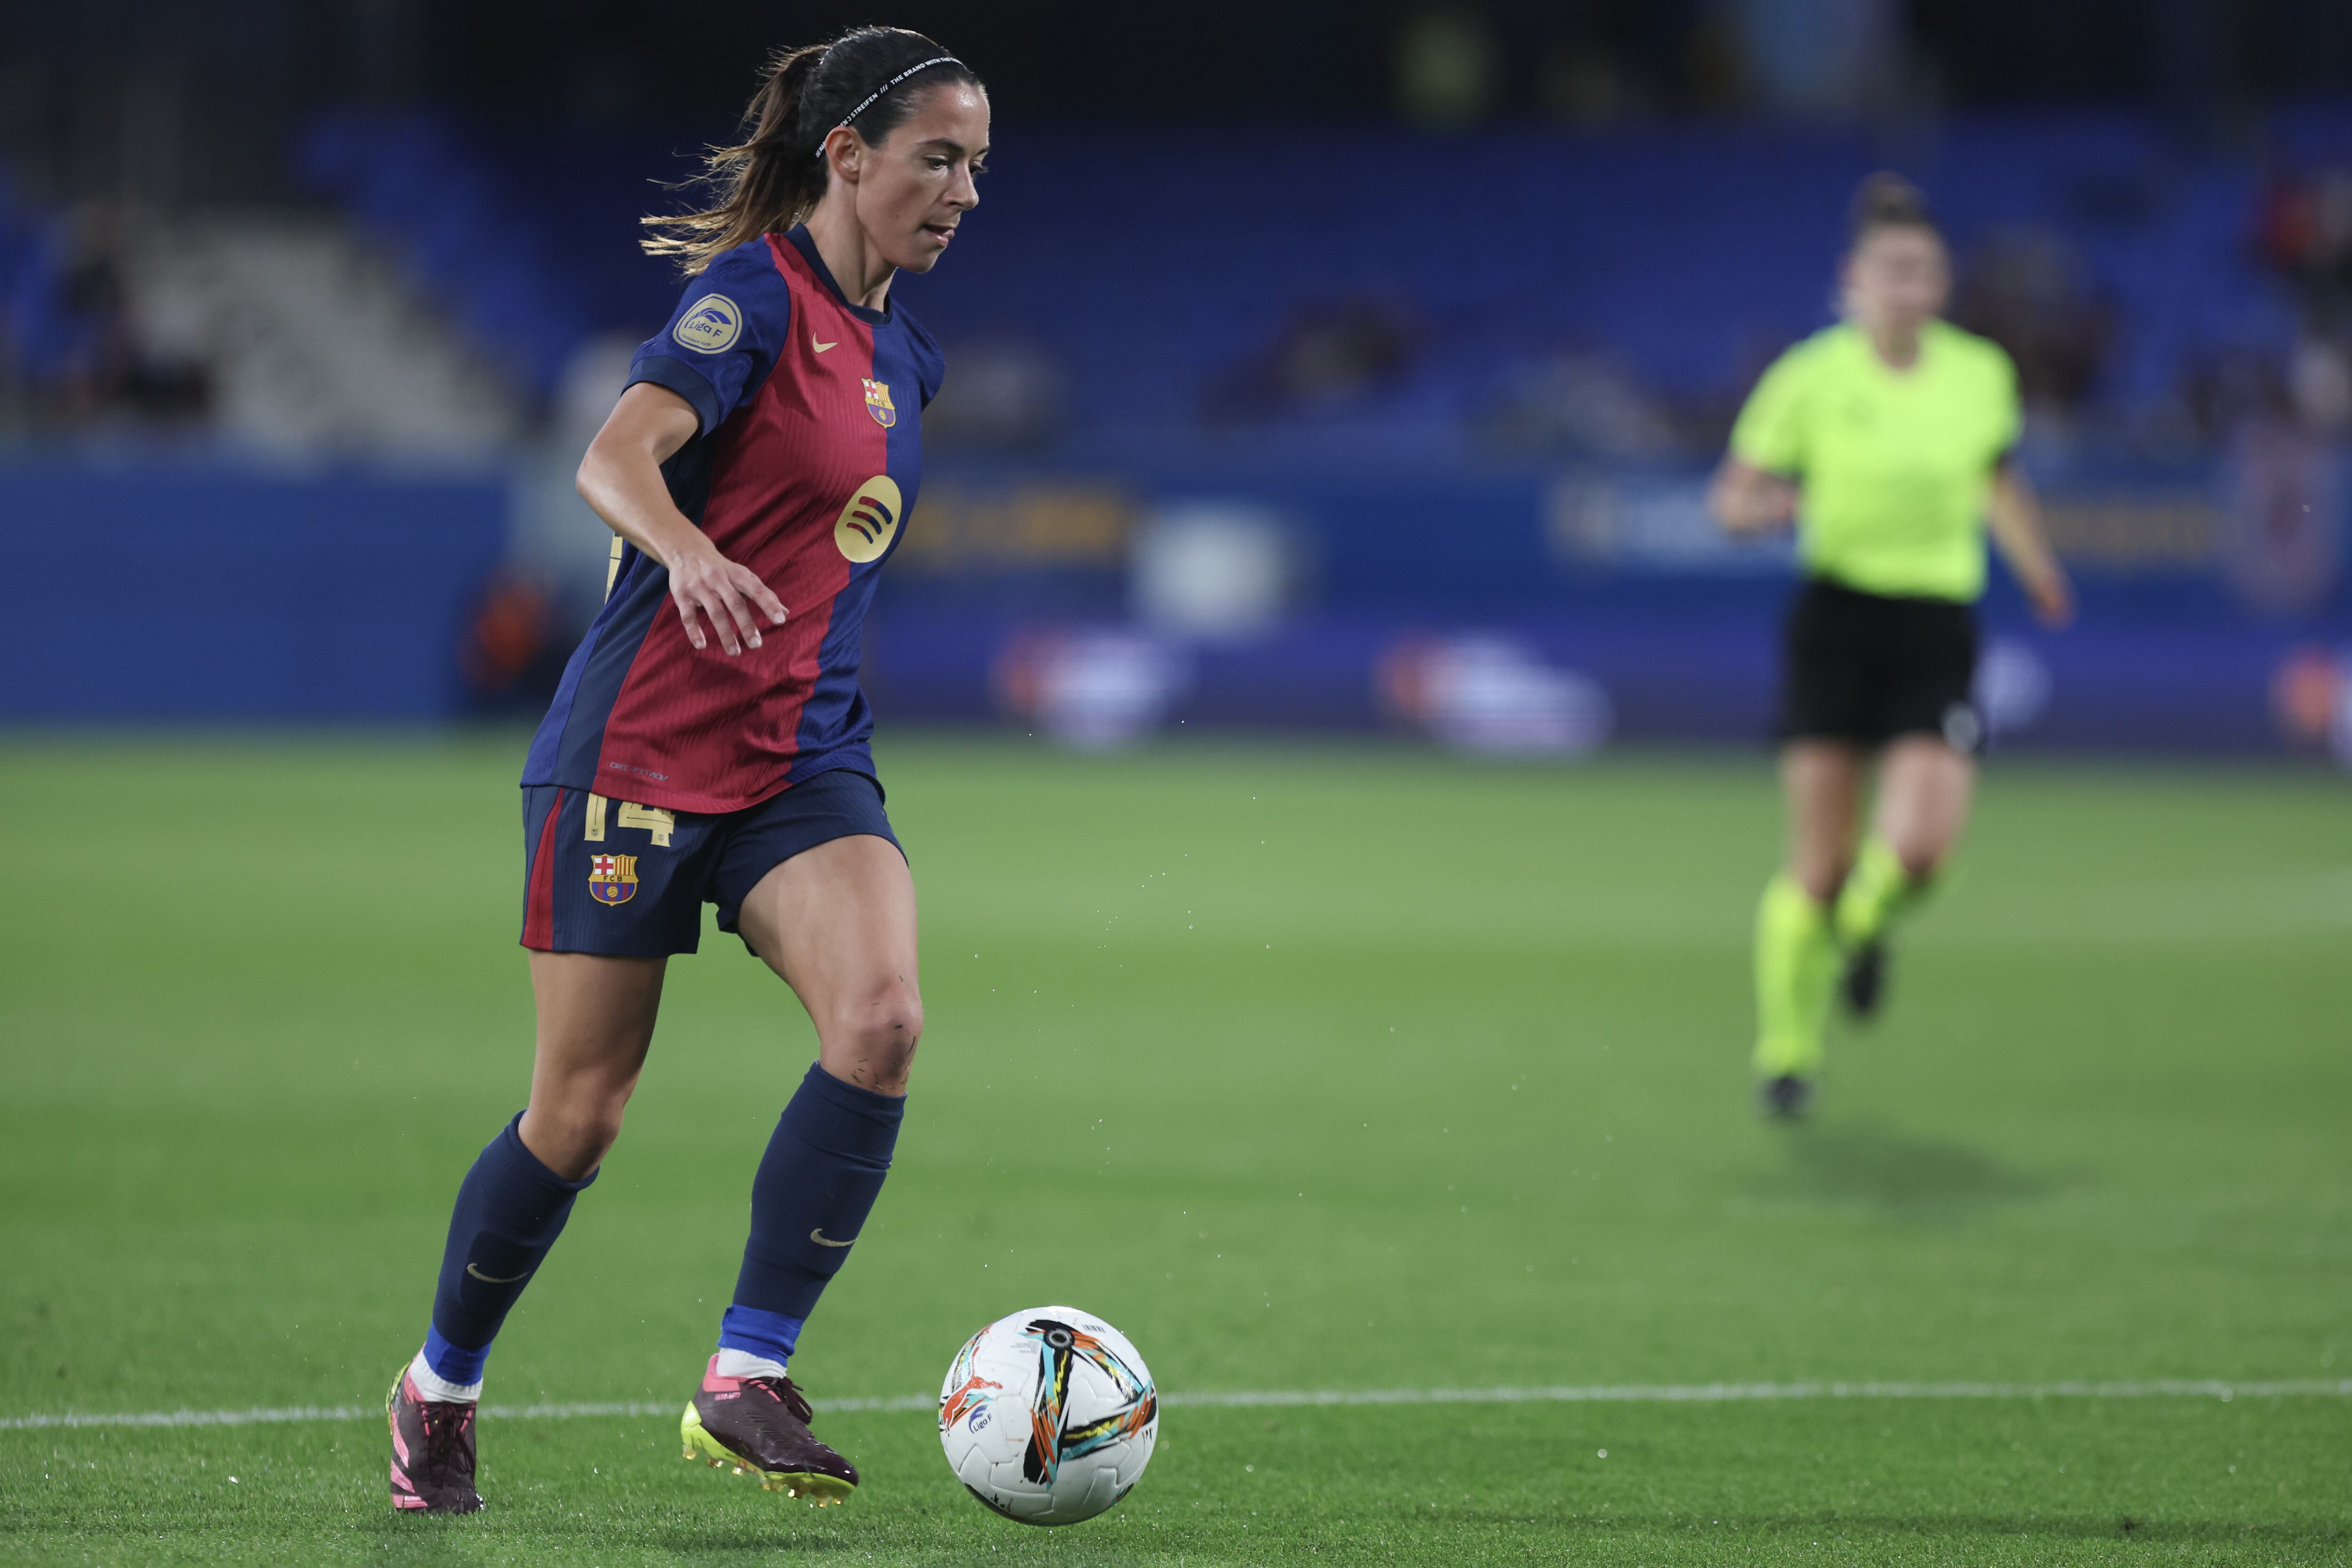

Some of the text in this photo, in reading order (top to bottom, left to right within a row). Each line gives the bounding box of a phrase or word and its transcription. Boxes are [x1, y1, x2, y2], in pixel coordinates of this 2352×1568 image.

[850, 93, 879, 118] STREIFEN
[890, 74, 904, 85] THE
[903, 63, 926, 78] BRAND
[924, 57, 942, 67] WITH
[688, 321, 723, 337] Liga F
[584, 792, 676, 847] 14
[973, 1419, 987, 1432] Liga
